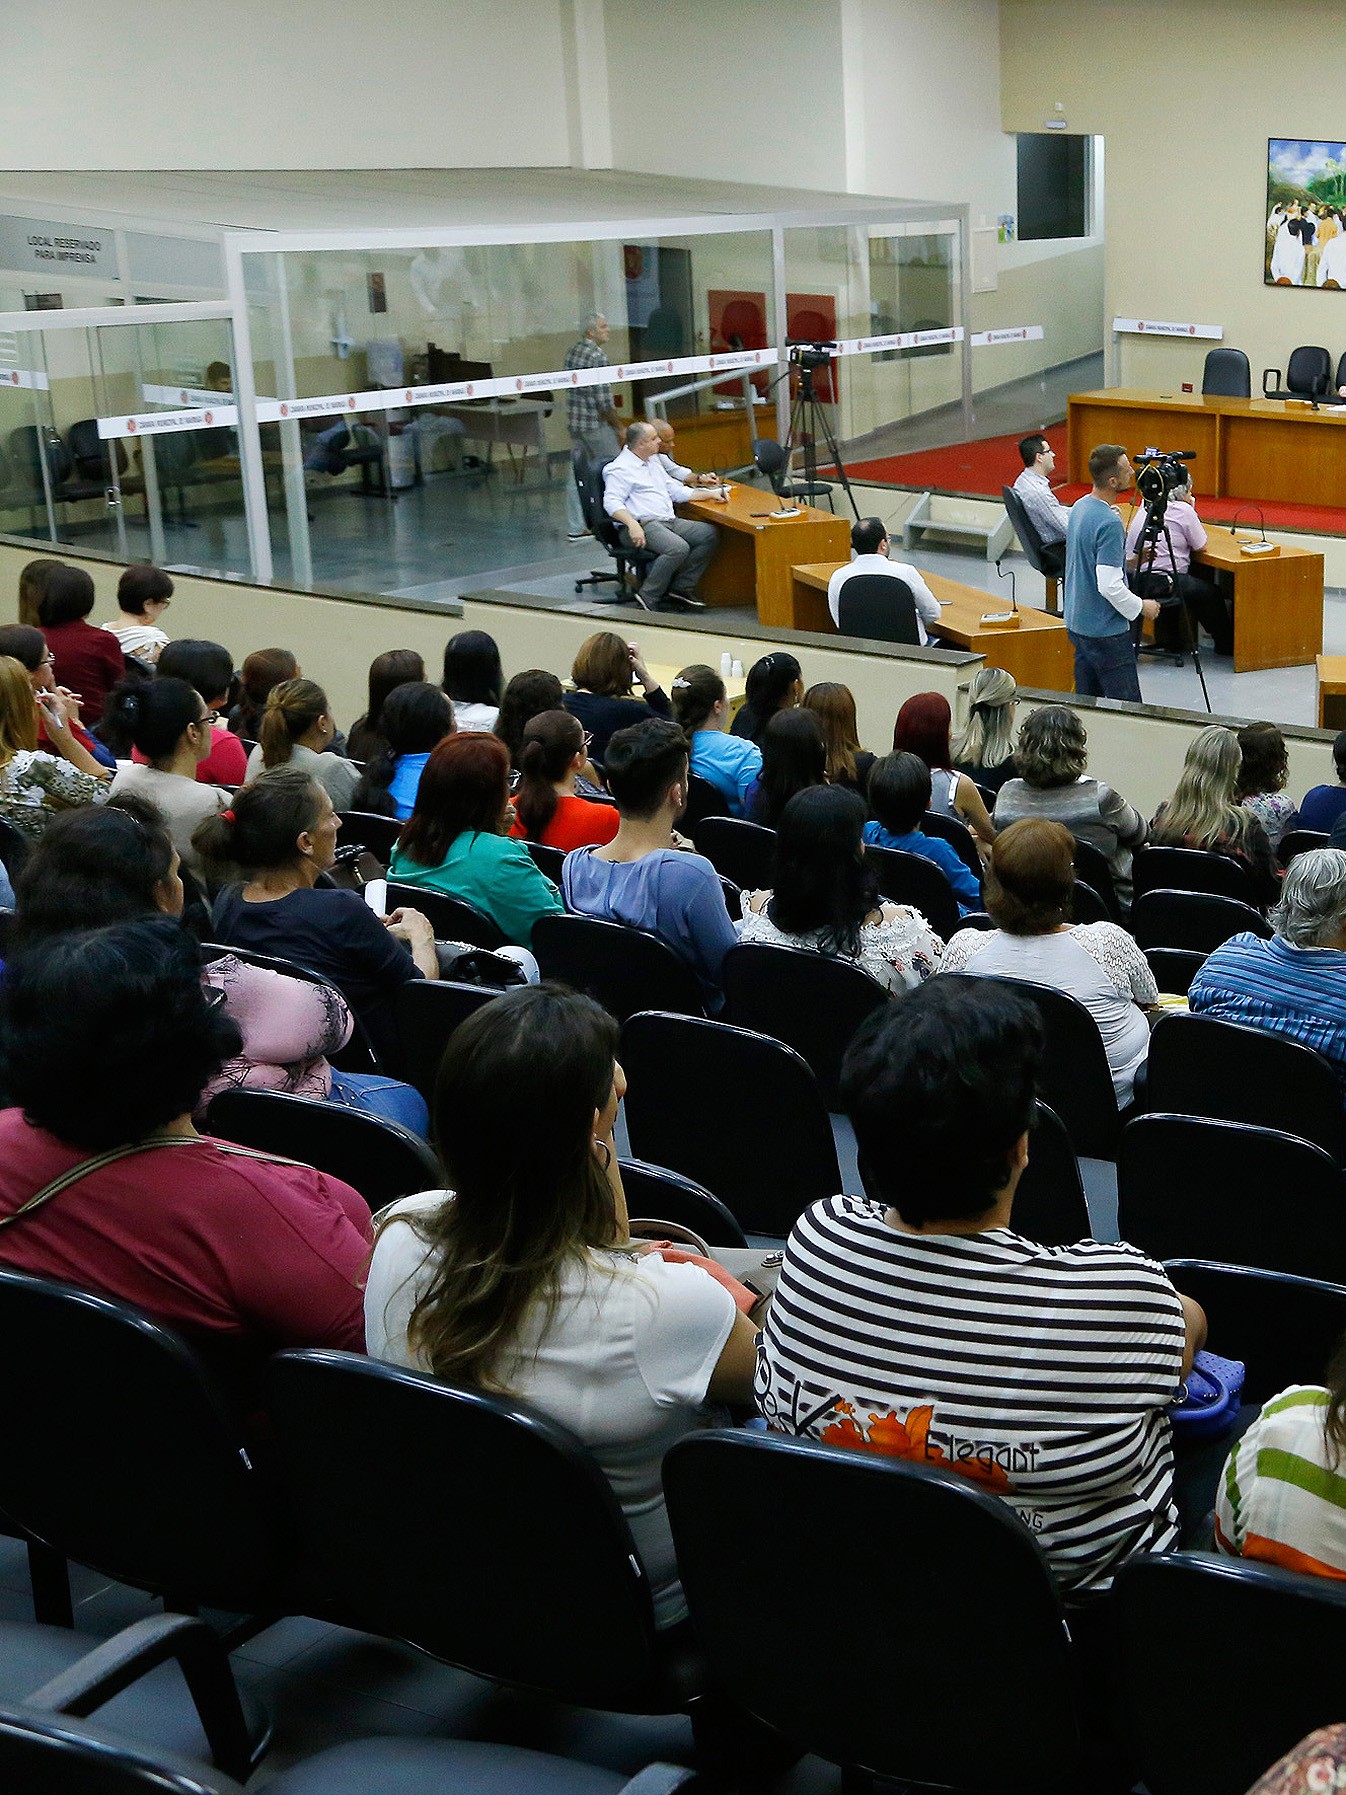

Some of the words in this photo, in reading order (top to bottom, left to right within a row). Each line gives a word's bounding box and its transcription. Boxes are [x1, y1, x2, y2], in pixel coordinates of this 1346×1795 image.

[27, 235, 53, 247] LOCAL
[34, 249, 56, 260] PARA
[924, 1430, 1040, 1475] Elegant
